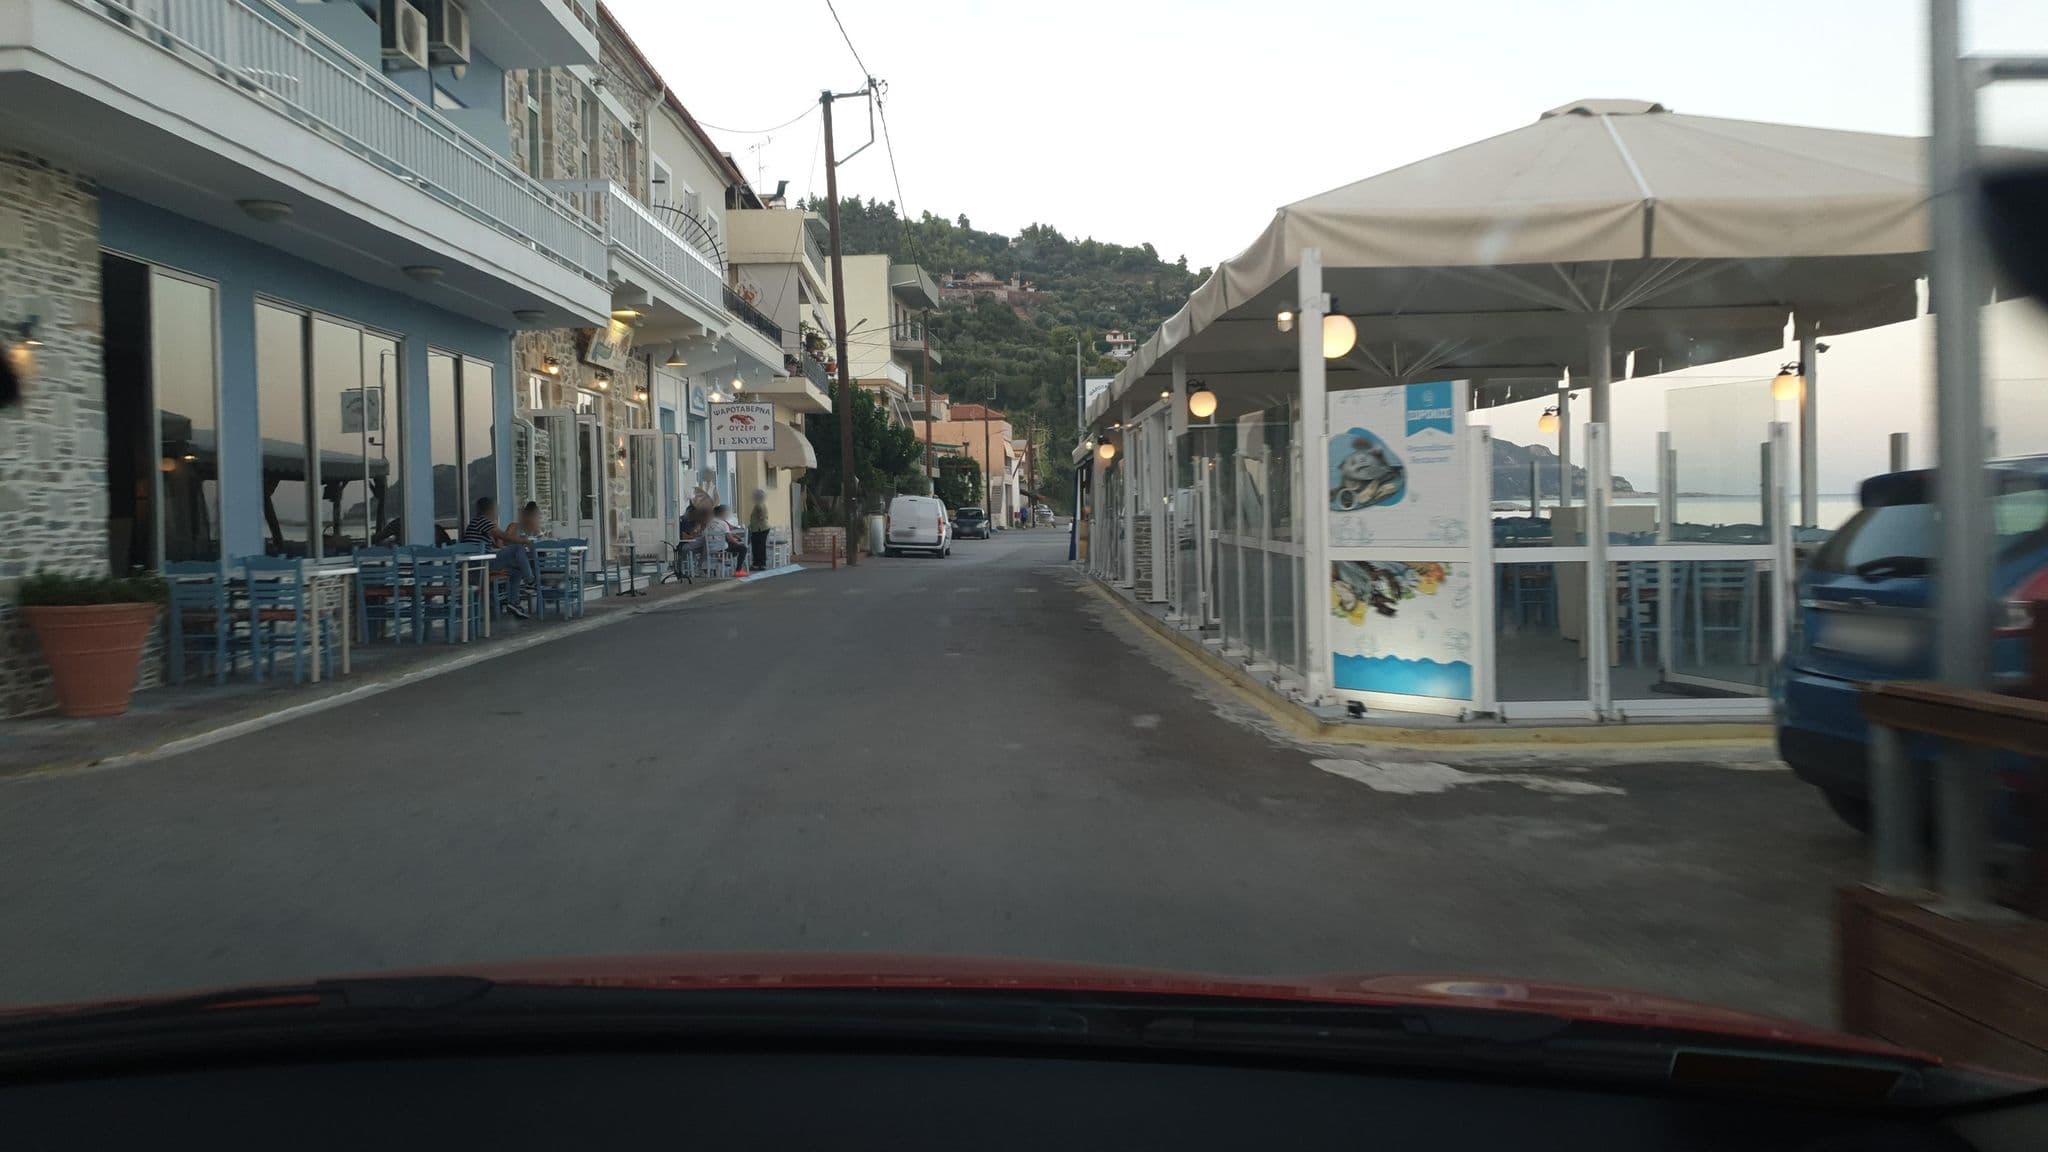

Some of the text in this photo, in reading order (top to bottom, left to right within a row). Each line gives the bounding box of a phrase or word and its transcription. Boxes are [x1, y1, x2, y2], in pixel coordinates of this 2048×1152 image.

[713, 405, 770, 416] ΨΑΡΟΤΑΒΕΡΝΑ
[718, 437, 768, 445] Η ΣΚΥΡΟΣ
